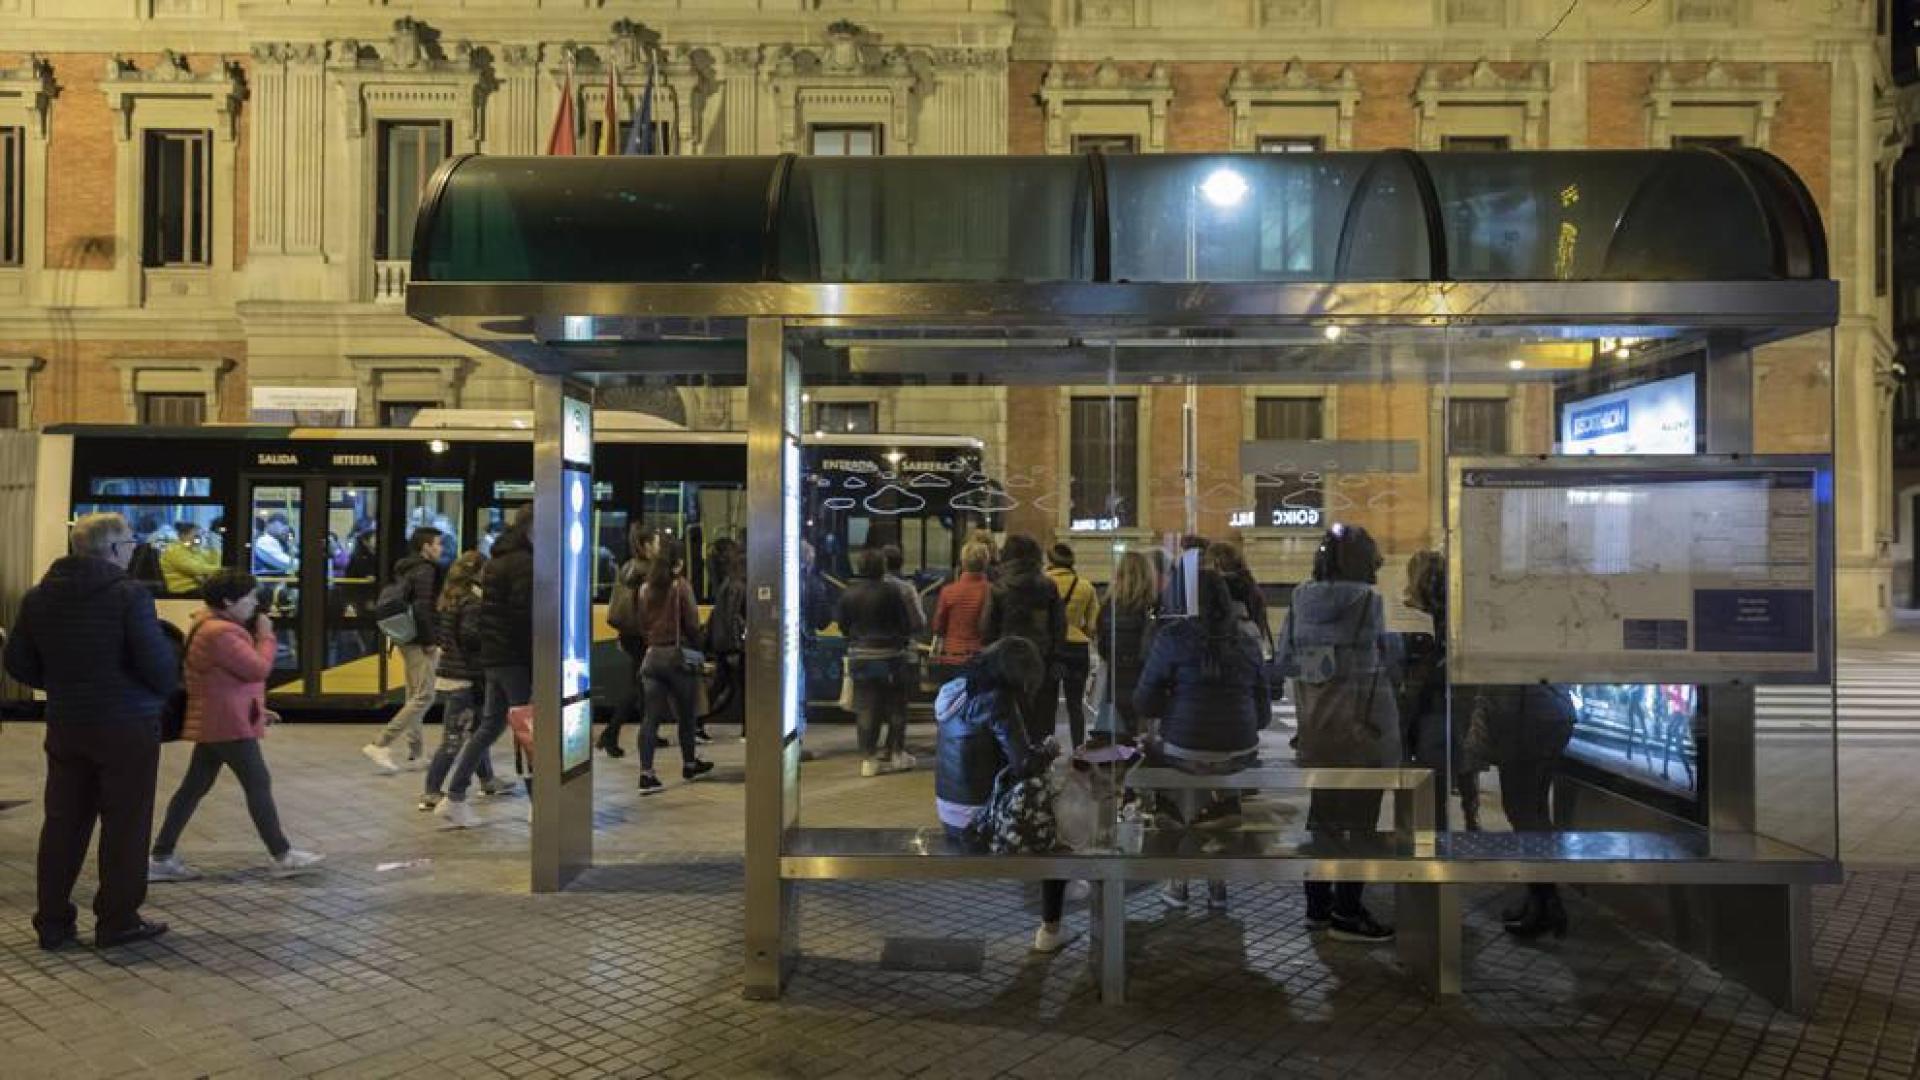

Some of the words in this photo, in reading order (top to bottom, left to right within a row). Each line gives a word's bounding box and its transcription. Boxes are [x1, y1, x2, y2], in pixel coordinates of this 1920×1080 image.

[257, 453, 297, 464] SALIDA
[333, 454, 377, 465] IRTEERA
[822, 458, 878, 472] ENTRADA
